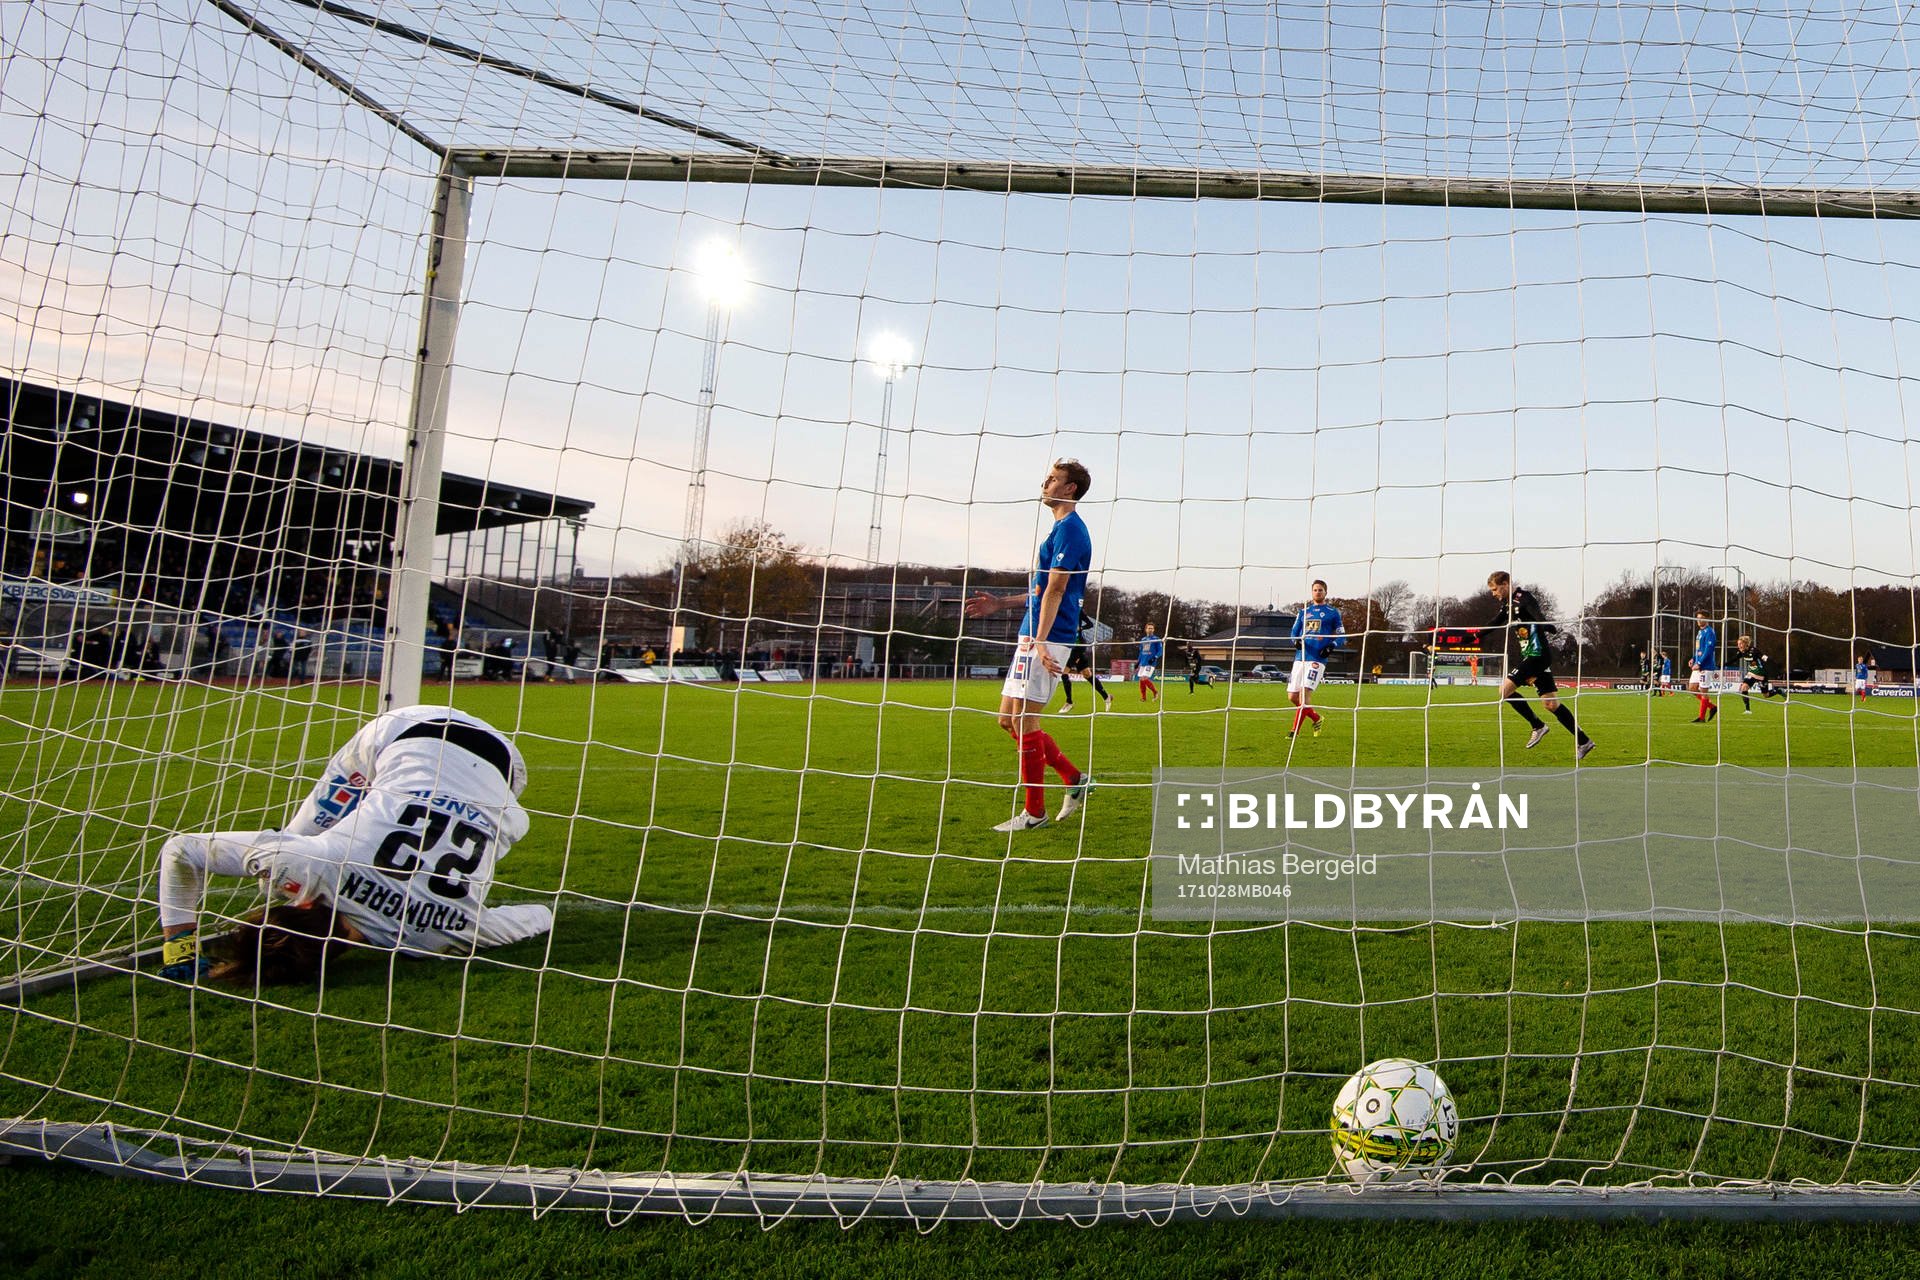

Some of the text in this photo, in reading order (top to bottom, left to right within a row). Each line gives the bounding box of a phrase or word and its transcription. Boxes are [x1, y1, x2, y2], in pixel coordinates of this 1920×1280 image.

[1871, 688, 1913, 697] Caverion
[373, 804, 489, 899] 22
[338, 871, 469, 934] STRÖMGREN
